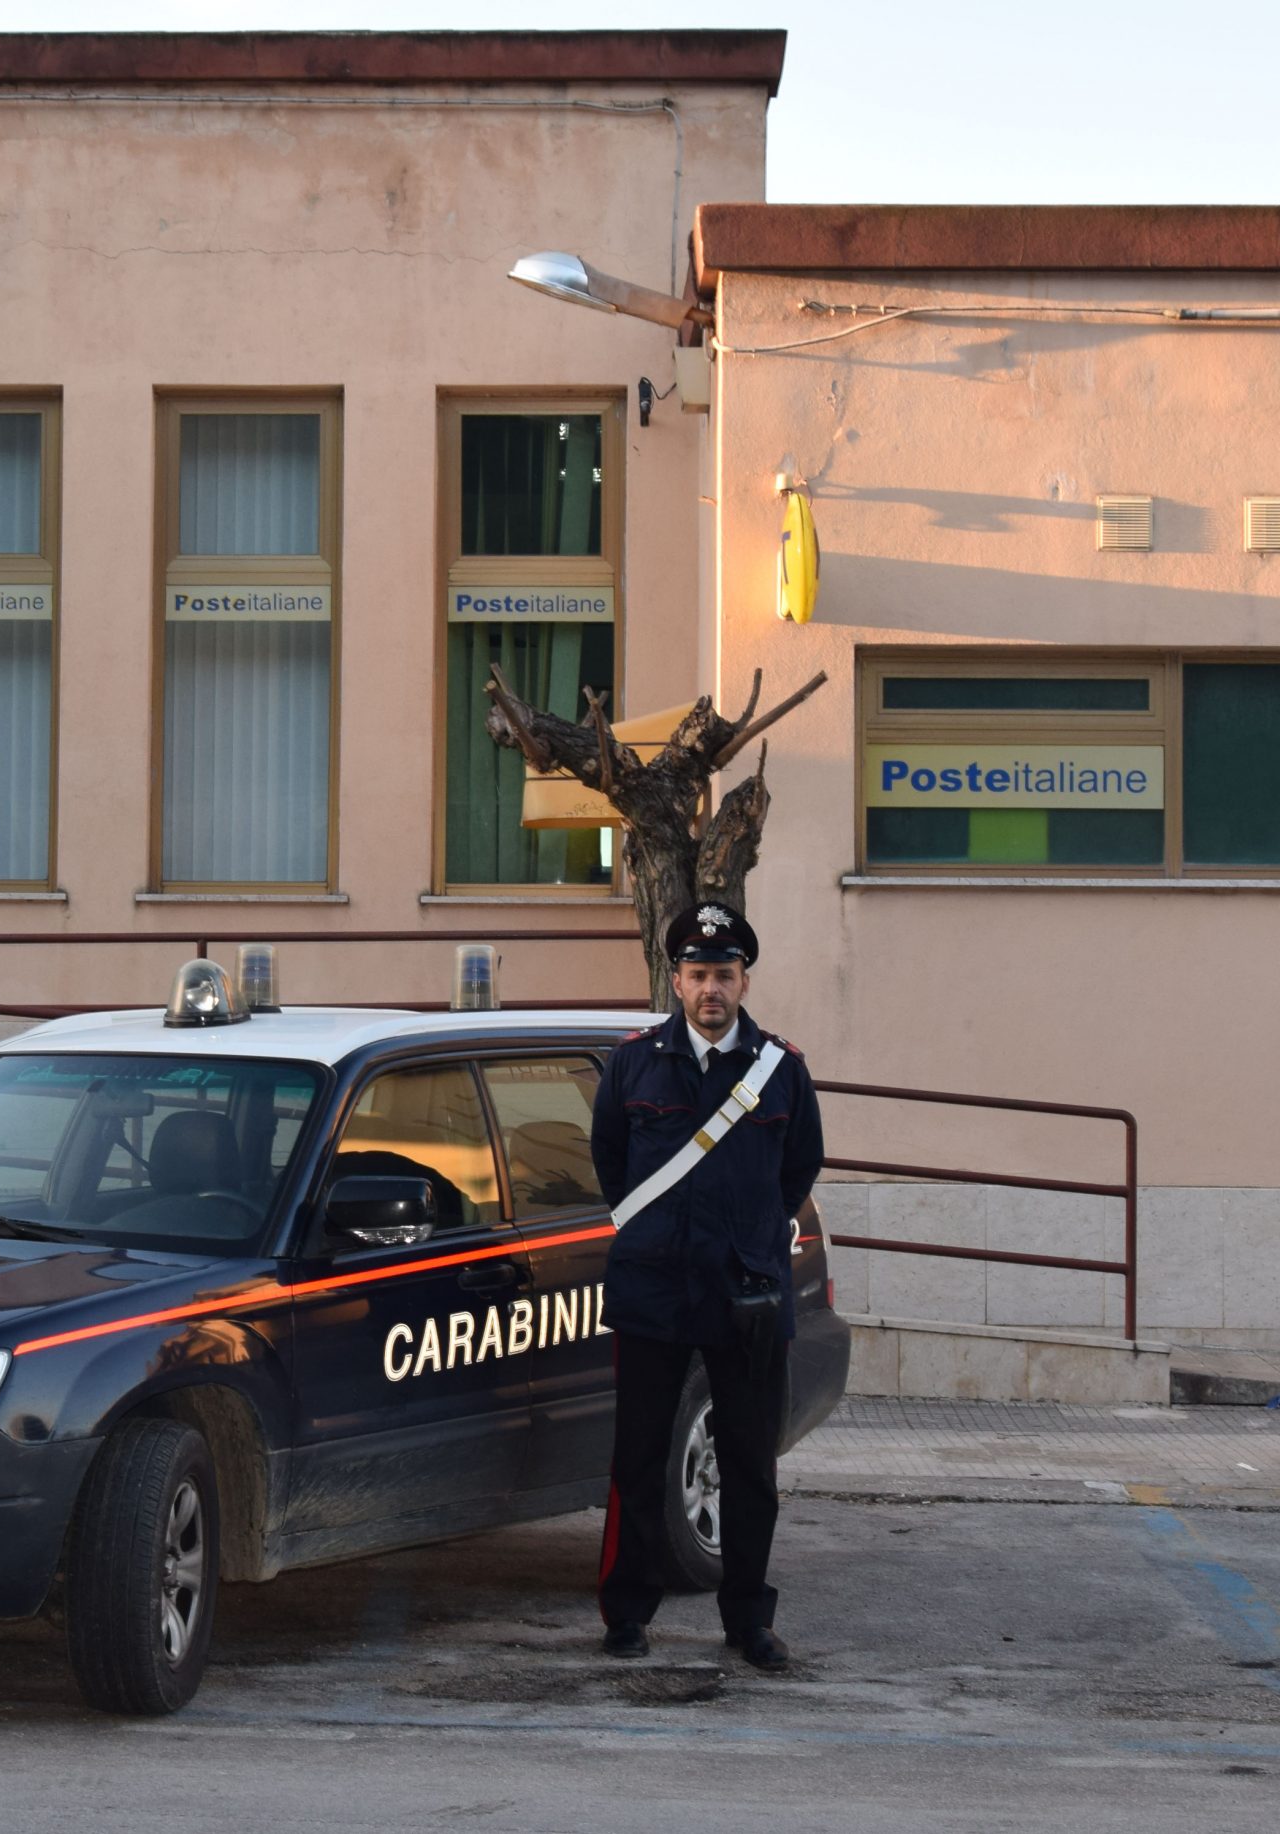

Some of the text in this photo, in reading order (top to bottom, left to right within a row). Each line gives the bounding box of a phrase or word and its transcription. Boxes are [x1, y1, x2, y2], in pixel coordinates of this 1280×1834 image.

[174, 592, 323, 612] Posteitaliane
[456, 594, 606, 613] Posteitaliane
[881, 760, 1148, 794] Posteitaliane
